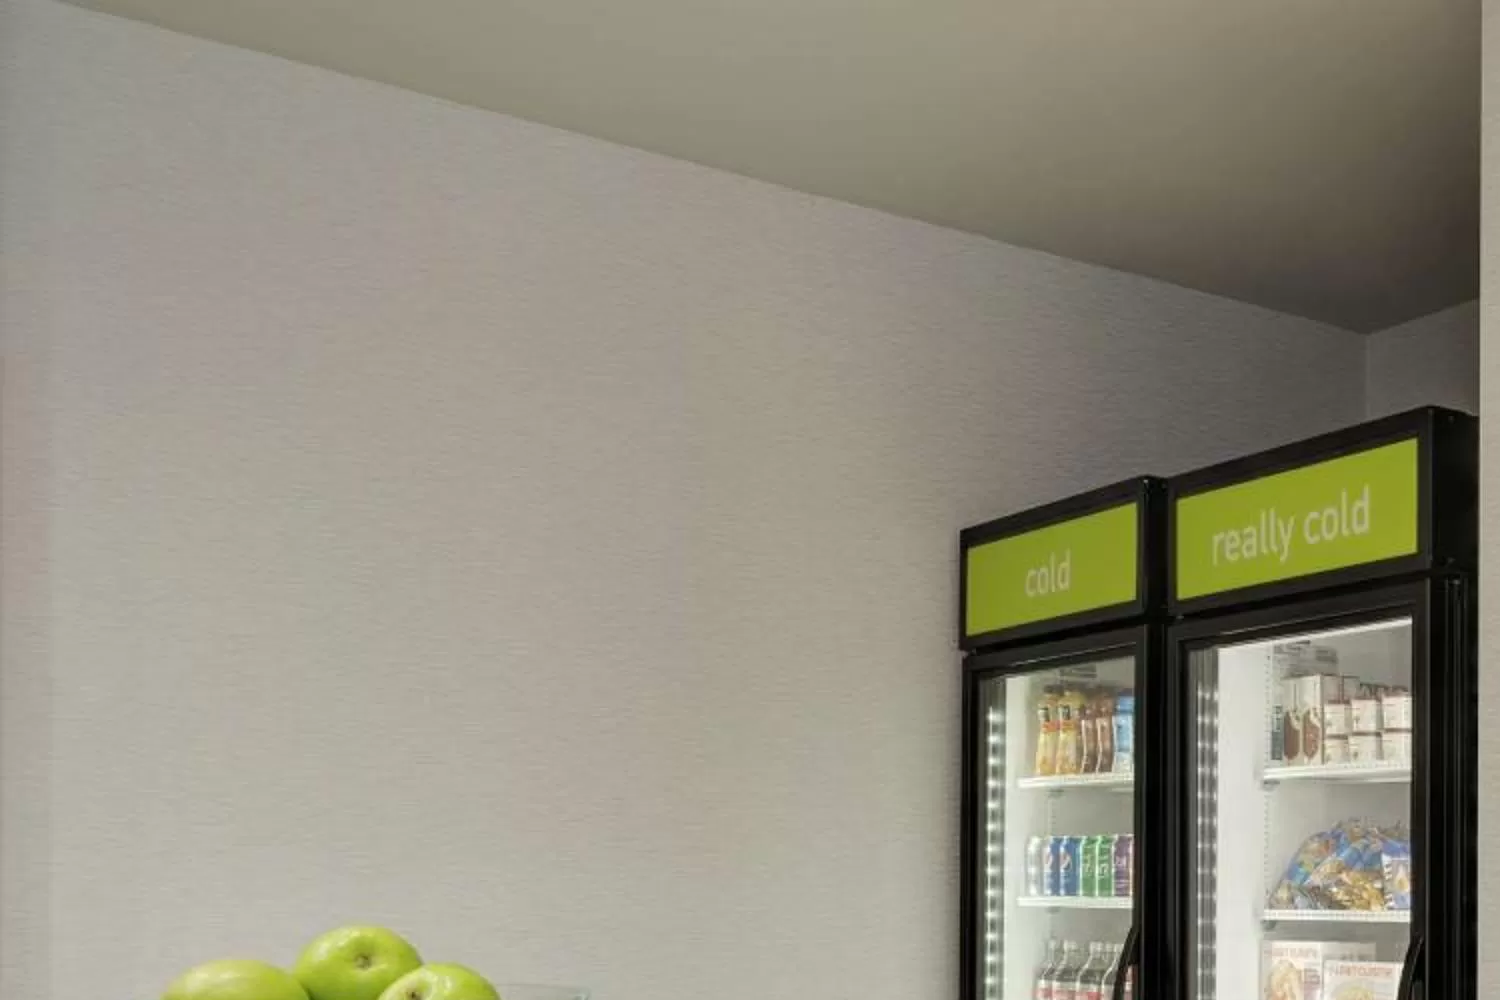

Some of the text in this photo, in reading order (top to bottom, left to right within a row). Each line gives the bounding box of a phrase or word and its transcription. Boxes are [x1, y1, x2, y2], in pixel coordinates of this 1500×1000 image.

[1211, 483, 1371, 566] really cold
[1024, 548, 1073, 599] cold
